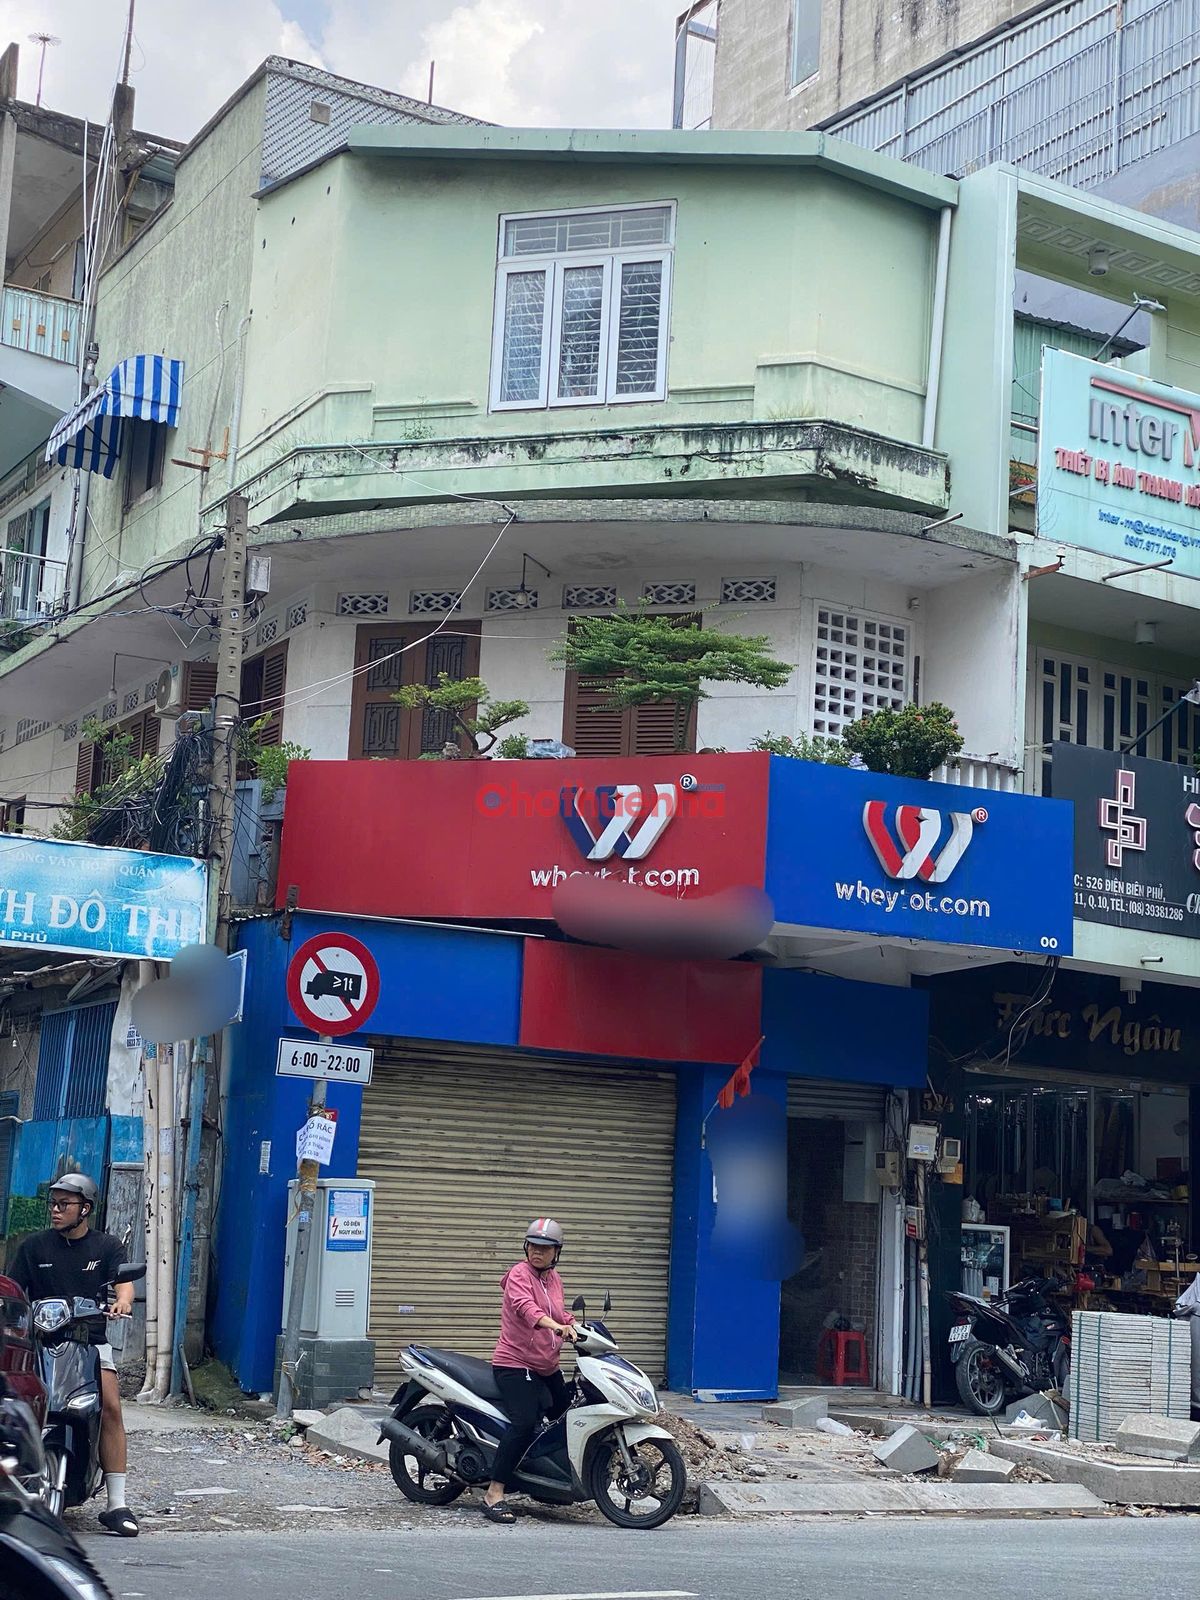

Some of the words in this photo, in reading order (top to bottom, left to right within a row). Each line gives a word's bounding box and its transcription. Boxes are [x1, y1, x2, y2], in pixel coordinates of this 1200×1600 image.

[1138, 472, 1183, 503] THANH
[835, 880, 991, 918] wheyot.com
[1086, 876, 1103, 890] 526
[1125, 881, 1145, 896] BIÊN
[48, 889, 107, 933] ĐÔ
[11, 929, 48, 943] PHỦ
